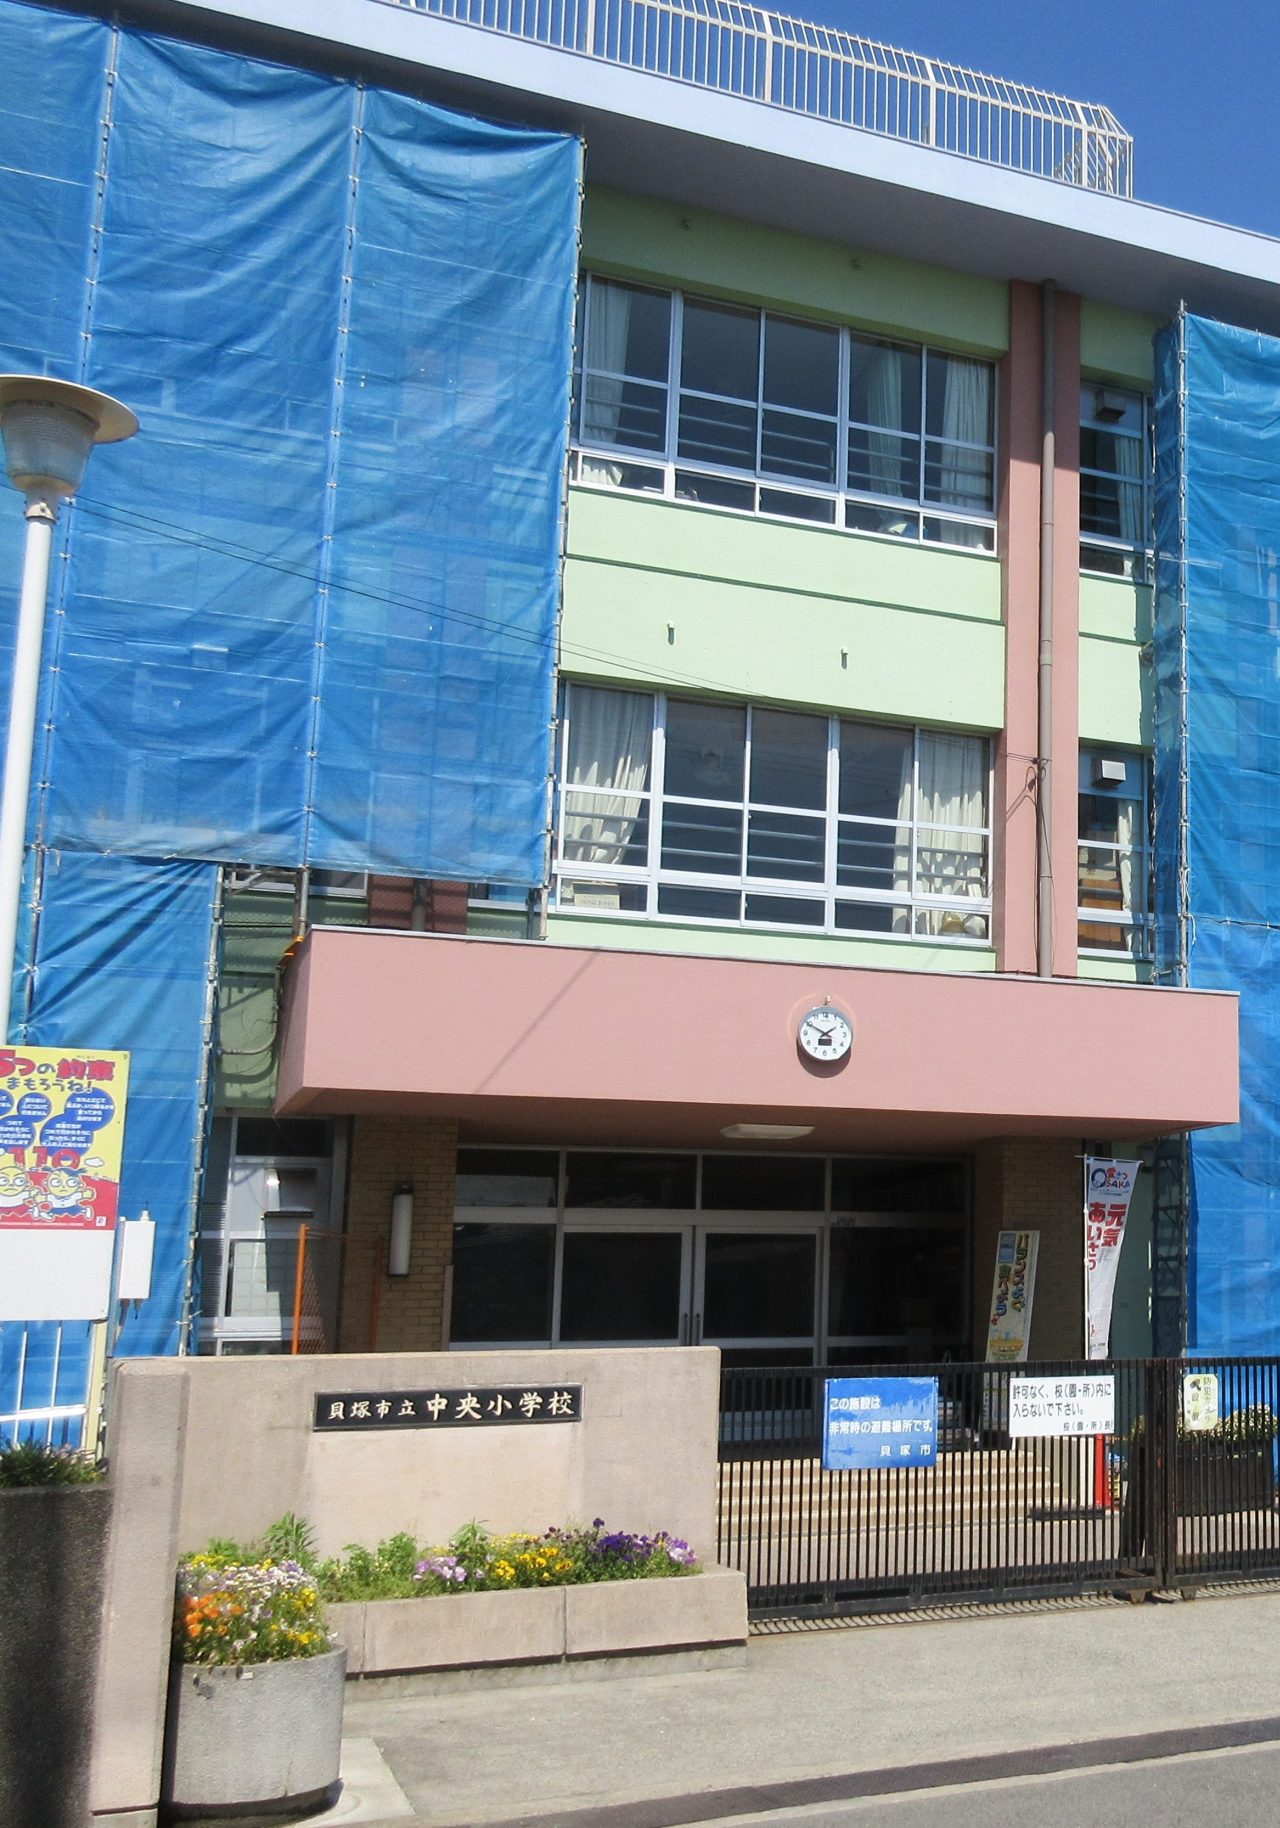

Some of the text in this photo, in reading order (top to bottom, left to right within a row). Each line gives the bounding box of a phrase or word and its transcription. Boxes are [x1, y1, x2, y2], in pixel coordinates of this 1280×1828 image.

[1088, 1202, 1106, 1271] あいさつ
[1101, 1203, 1127, 1247] 元気
[327, 1391, 575, 1421] 貝塚市立中央小学校
[829, 1395, 881, 1411] この施設は
[1012, 1402, 1084, 1418] 入らないで下さい。
[828, 1419, 934, 1436] 非常時の避難場所です。
